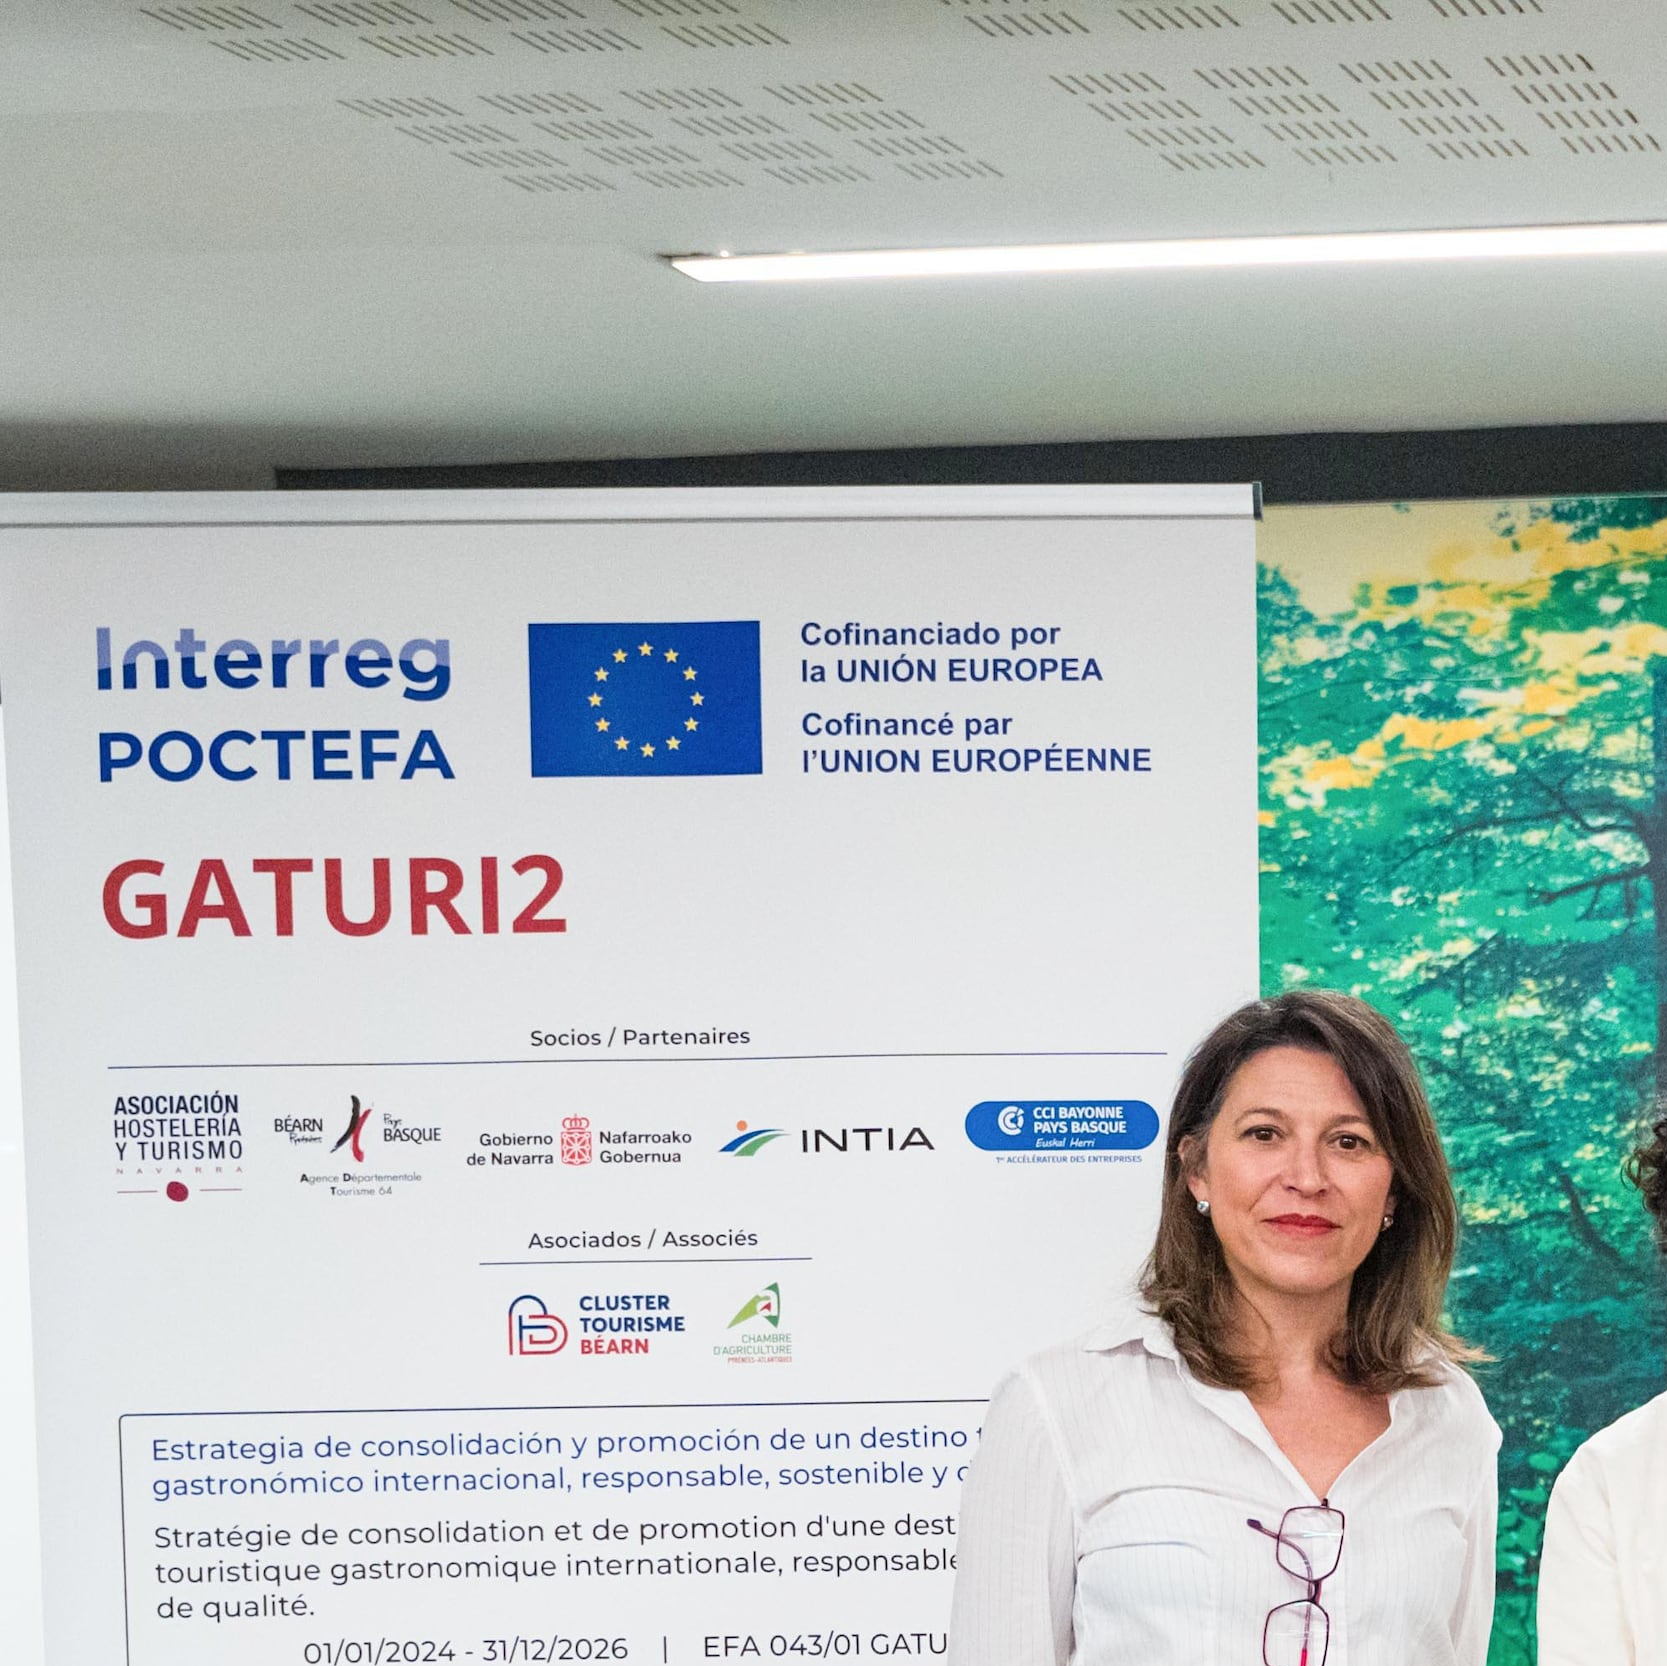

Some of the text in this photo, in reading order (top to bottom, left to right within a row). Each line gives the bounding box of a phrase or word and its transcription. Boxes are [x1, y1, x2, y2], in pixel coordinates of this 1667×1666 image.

[800, 621, 1062, 651] Cofinanciado por
[96, 627, 451, 701] Interreg
[801, 653, 1104, 683] la UNIÓN EUROPEA
[801, 711, 1013, 742] Cofinancé par
[99, 729, 455, 782] POCTEFA
[803, 742, 1152, 774] l’UNION EUROPÉENNE
[102, 854, 567, 939] GATURI2
[530, 1026, 751, 1048] Socios / Partenaires
[113, 1091, 239, 1115] ASOCIACIÓN
[1032, 1106, 1124, 1120] CCI BAYONNE
[113, 1117, 242, 1139] HOSTELERÍA
[274, 1113, 323, 1133] BÉARN
[1033, 1120, 1127, 1135] PAYS BASQUE
[383, 1127, 442, 1145] BASQUE
[479, 1132, 554, 1147] Gobierno
[599, 1130, 692, 1145] Nafarroako
[801, 1127, 935, 1153] INTIA
[1035, 1136, 1096, 1148] Euskal Herri
[115, 1139, 243, 1161] Y TURISMO
[466, 1151, 554, 1166] de Navarra
[599, 1149, 682, 1164] Gobernua
[1006, 1153, 1069, 1164] ACCÉLÉRATEUR
[1069, 1154, 1087, 1164] DES
[1087, 1154, 1143, 1164] ENTREPRISES
[299, 1170, 423, 1186] Agence Départementale
[329, 1185, 393, 1197] Tourisme 64
[527, 1228, 759, 1250] Asociados / Associés
[579, 1294, 670, 1312] CLUSTER
[579, 1316, 686, 1333] TOURISME
[580, 1334, 649, 1355] BÉARN
[741, 1332, 793, 1344] CHAMBRE
[712, 1344, 793, 1356] D'AGRICULTURE
[152, 1435, 304, 1465] Estrategia
[313, 1435, 352, 1459] de
[361, 1431, 562, 1458] consolidación
[570, 1436, 588, 1460] y
[597, 1428, 760, 1459] promoción
[770, 1427, 806, 1451] de
[815, 1432, 851, 1450] un
[860, 1424, 968, 1449] destino
[152, 1470, 364, 1502] gastronómico
[374, 1466, 572, 1493] internacional,
[582, 1463, 770, 1494] responsable,
[778, 1460, 924, 1486] sostenible
[931, 1465, 949, 1489] y
[303, 1637, 457, 1666] 01/01/2024
[482, 1634, 629, 1664] 31/12/2026
[704, 1635, 762, 1658] EFA
[769, 1629, 860, 1659] 043/01
[870, 1632, 947, 1656] GATU
